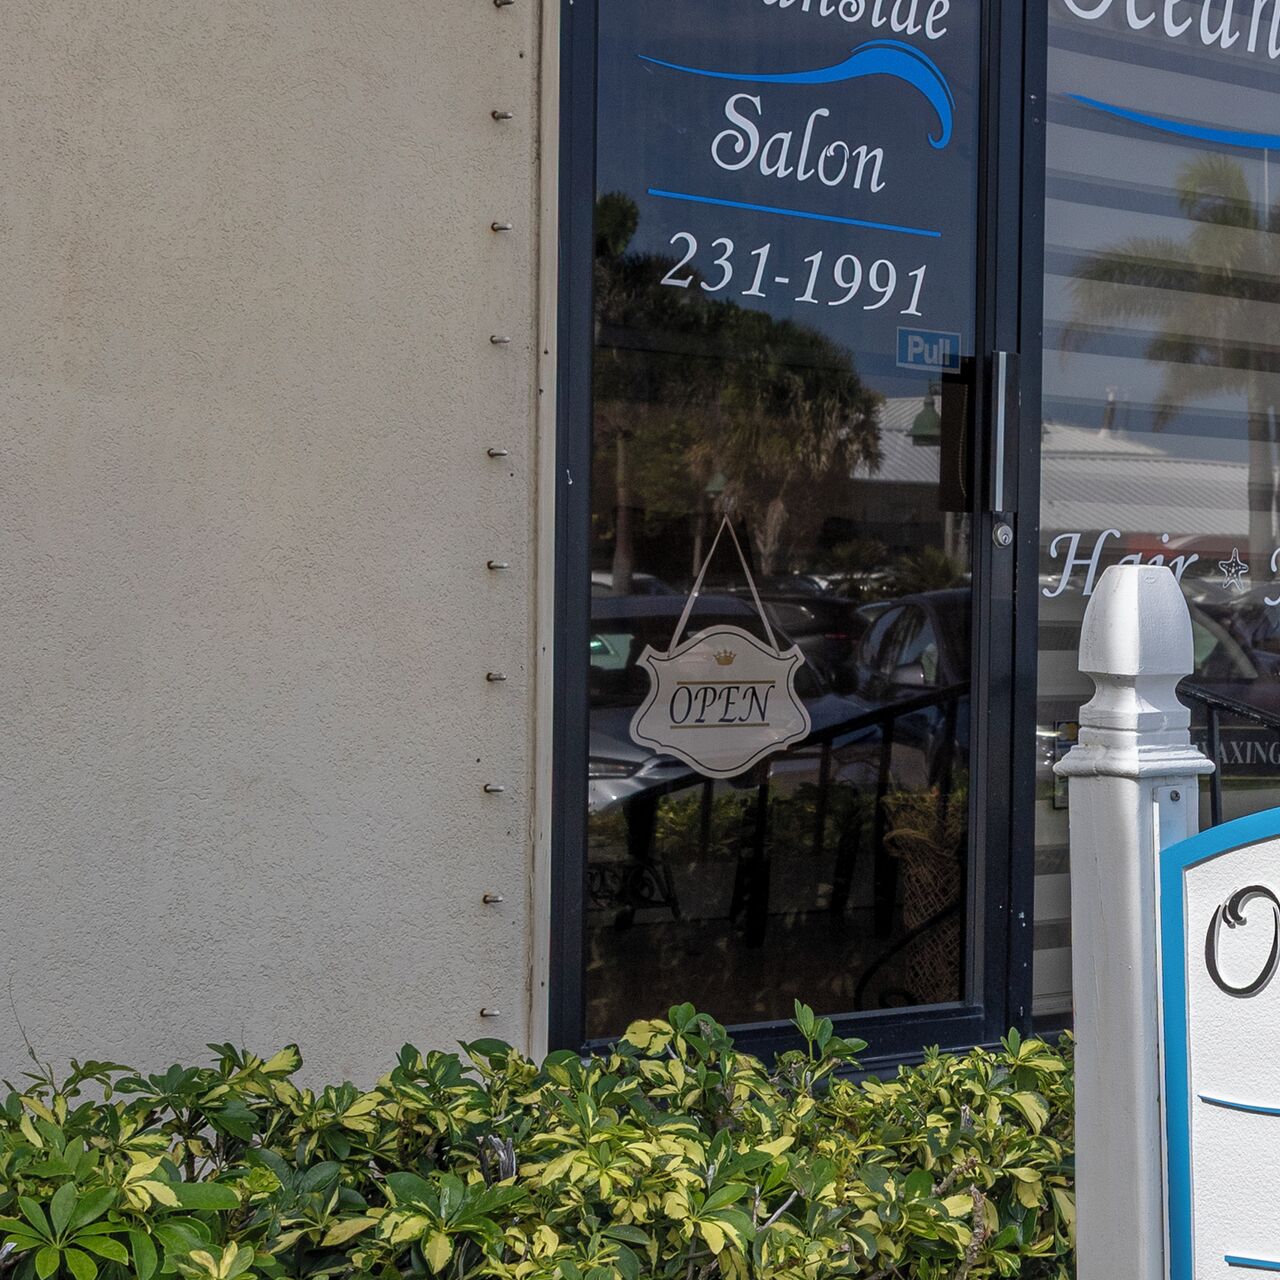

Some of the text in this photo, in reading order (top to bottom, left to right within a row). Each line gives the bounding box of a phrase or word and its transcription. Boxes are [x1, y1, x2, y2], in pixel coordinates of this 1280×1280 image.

[711, 93, 886, 194] Salon
[661, 232, 928, 318] 231-1991
[907, 334, 951, 366] Pull
[1042, 528, 1200, 598] Hr
[669, 685, 776, 725] OPEN
